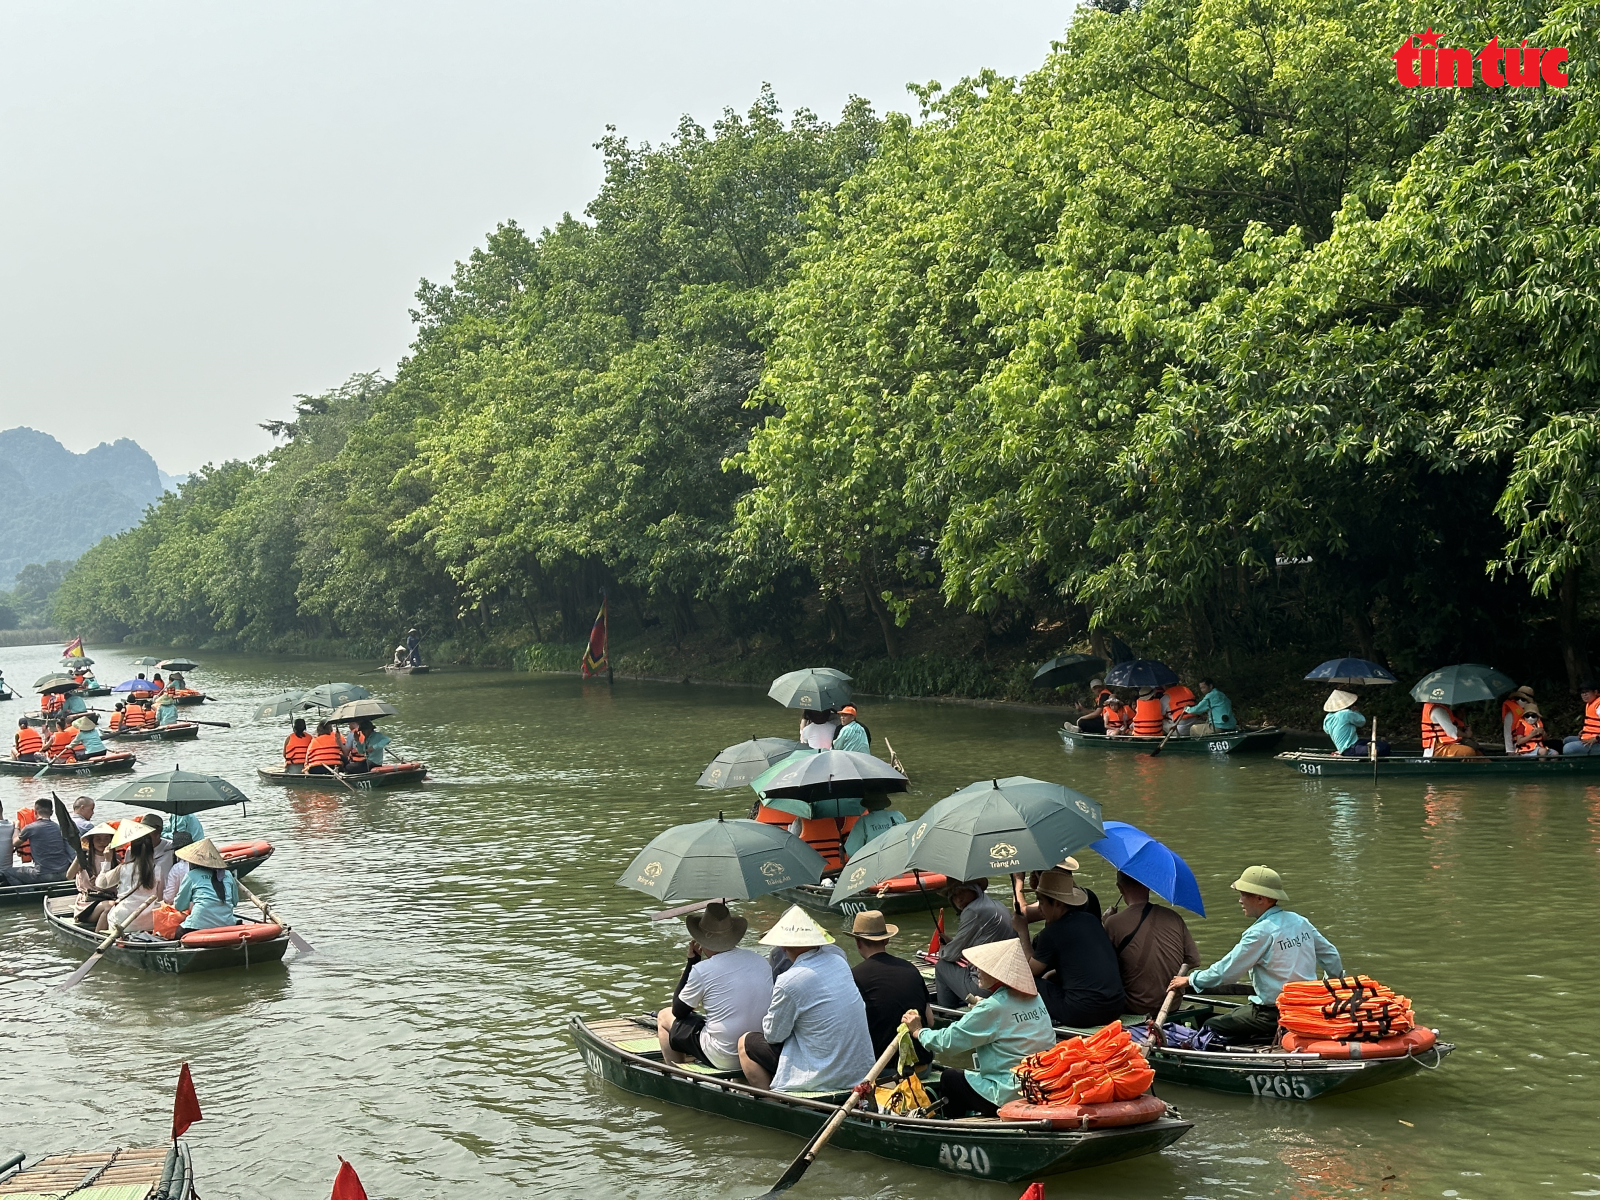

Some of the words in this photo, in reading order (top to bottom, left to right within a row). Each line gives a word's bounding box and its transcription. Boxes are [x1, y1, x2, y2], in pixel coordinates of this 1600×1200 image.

[1209, 741, 1230, 752] 560
[1300, 763, 1322, 775] 391
[357, 780, 371, 791] 377
[990, 860, 1009, 869] Tràng
[1009, 859, 1020, 867] An
[840, 902, 867, 916] 1003
[1277, 935, 1302, 951] Tràng
[1300, 931, 1311, 942] An
[1012, 1009, 1040, 1023] Tràng
[1245, 1074, 1311, 1099] 1265
[939, 1142, 990, 1175] 420
